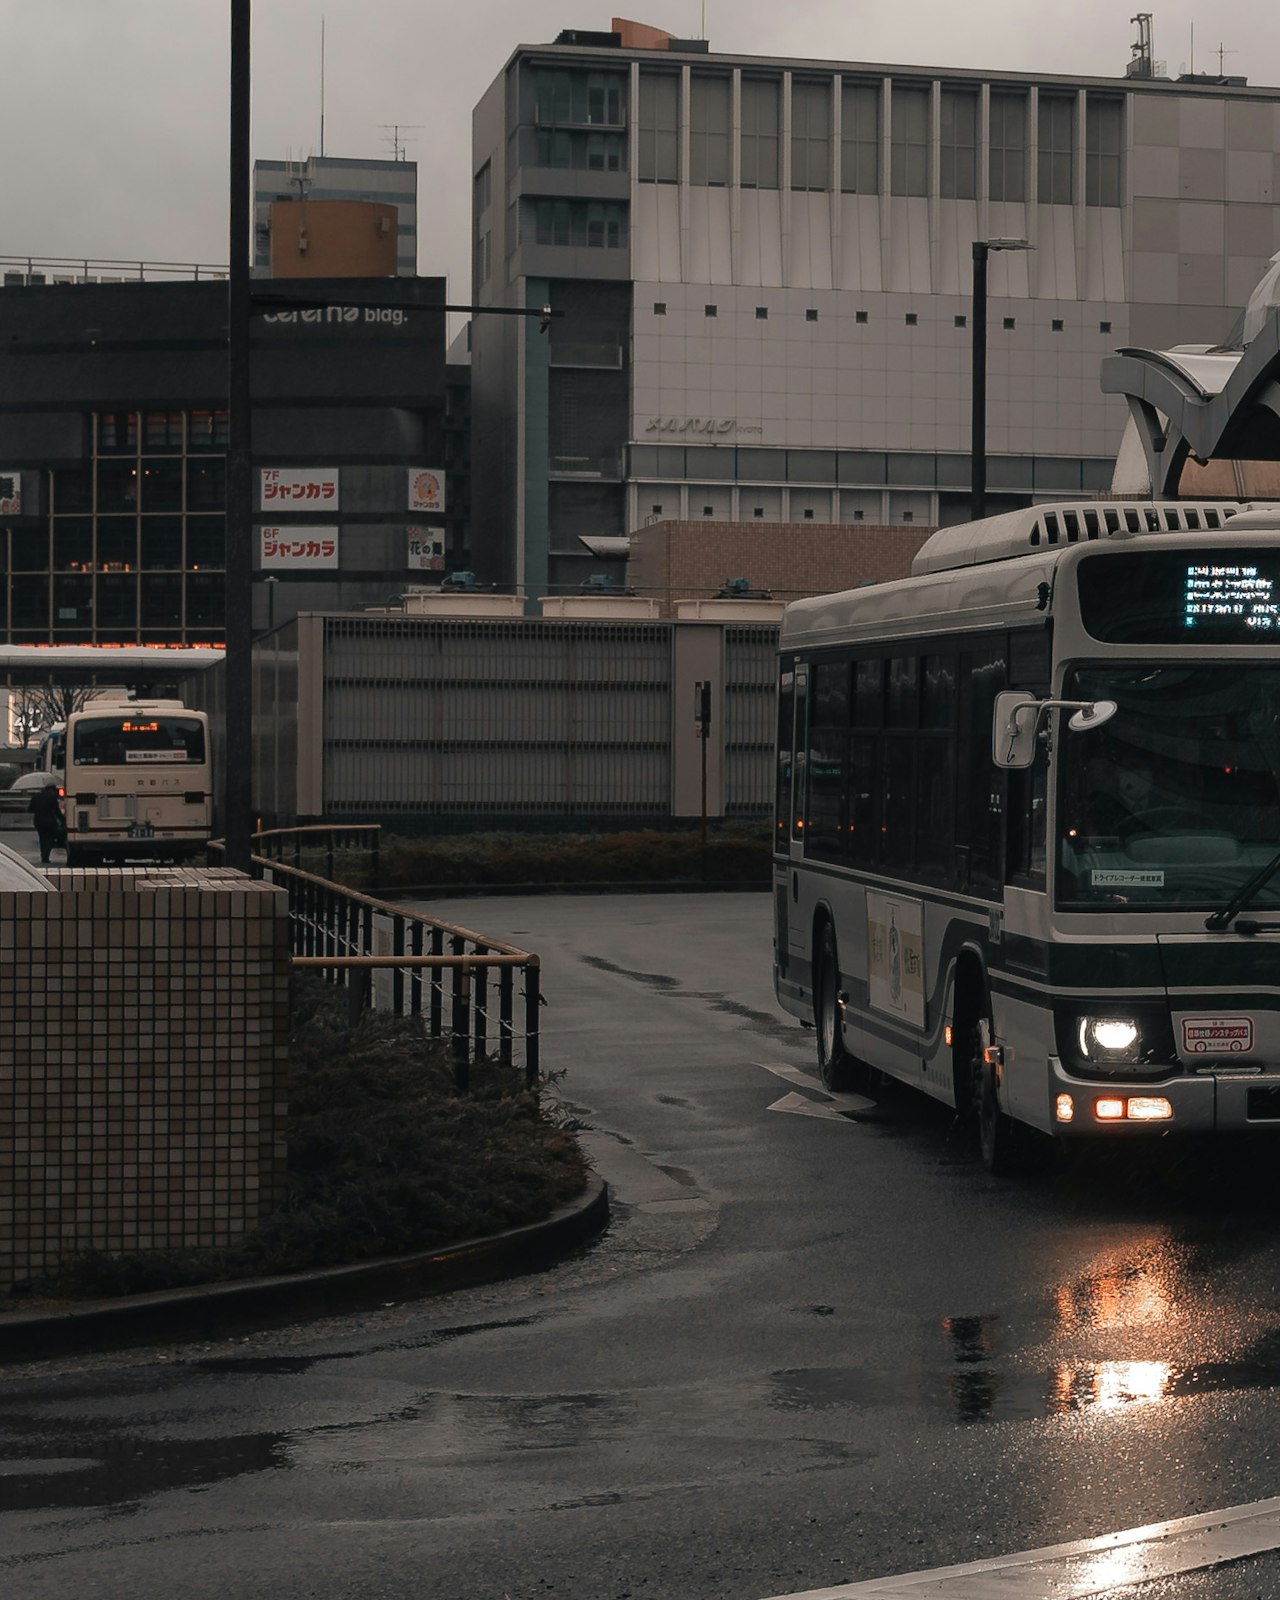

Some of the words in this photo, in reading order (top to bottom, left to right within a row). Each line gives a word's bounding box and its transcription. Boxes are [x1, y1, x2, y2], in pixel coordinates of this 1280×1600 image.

[365, 307, 408, 325] bldg.
[264, 471, 279, 480] 7F
[264, 483, 335, 499] ジャンカラ
[413, 500, 440, 508] ジャンカラ
[264, 529, 279, 538] 6F
[264, 541, 335, 557] ジャンカラ
